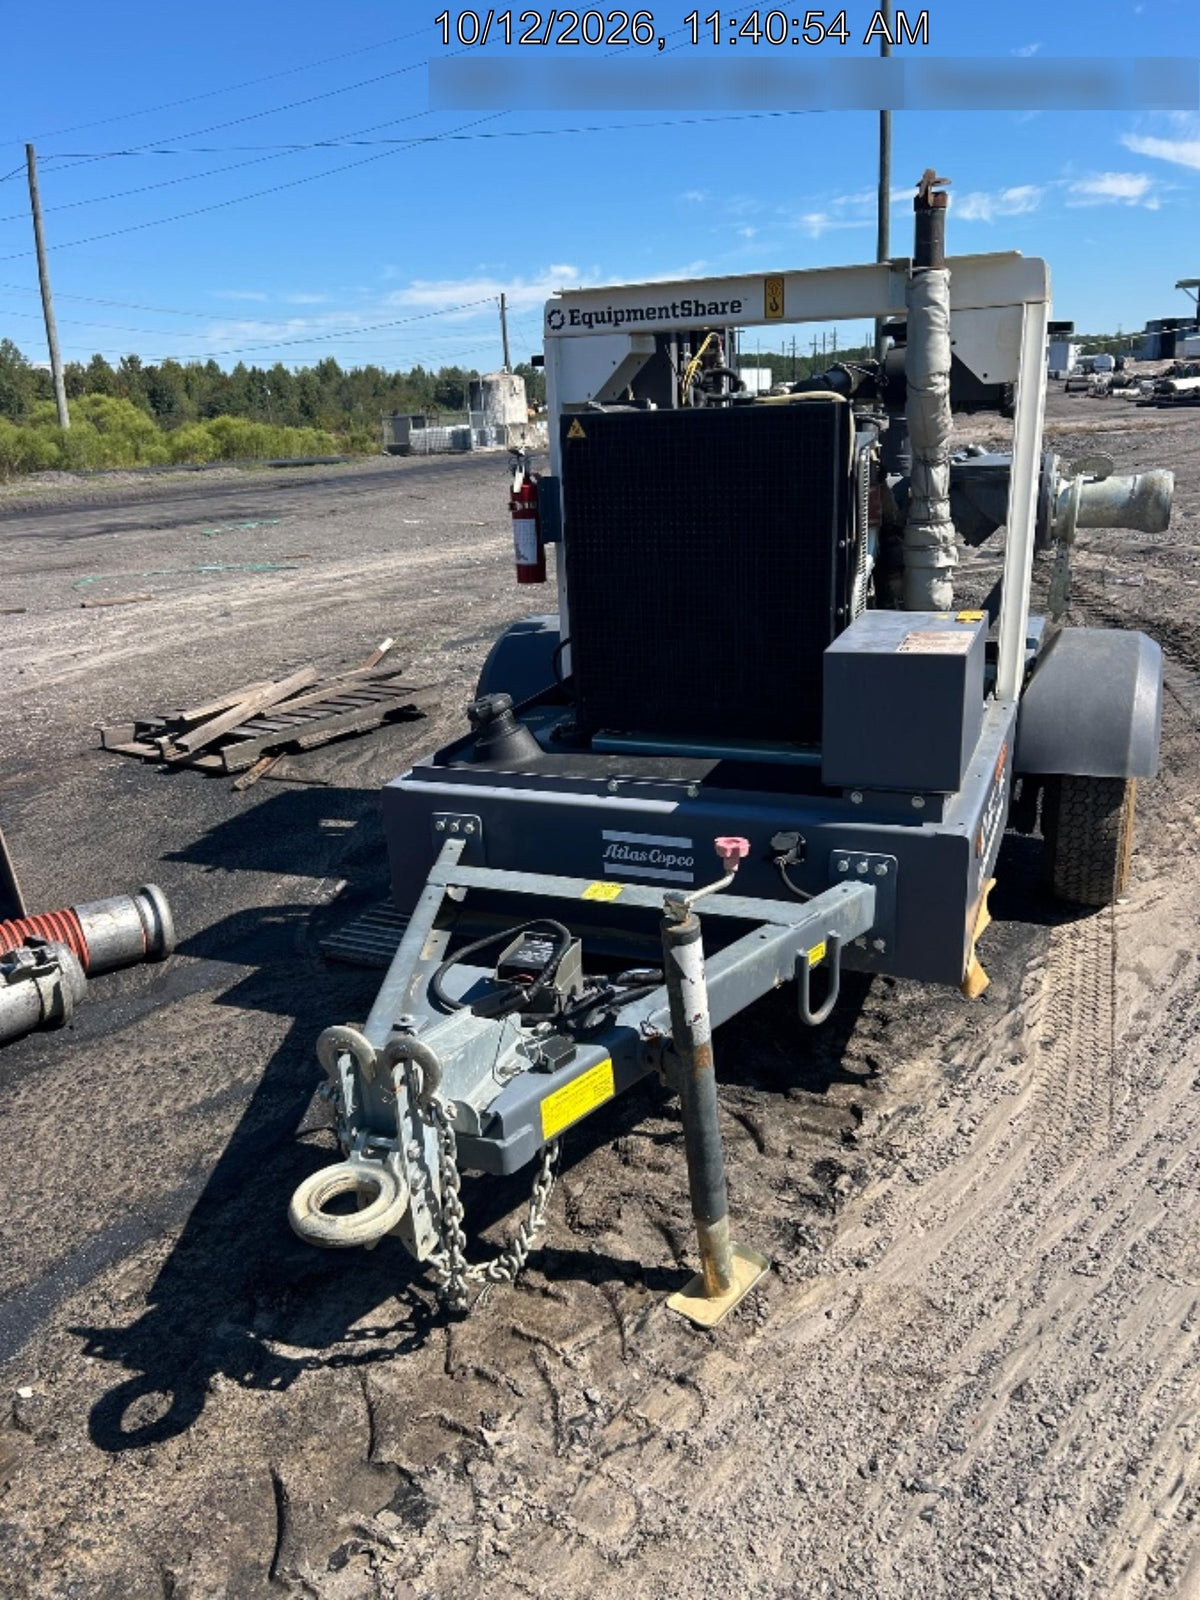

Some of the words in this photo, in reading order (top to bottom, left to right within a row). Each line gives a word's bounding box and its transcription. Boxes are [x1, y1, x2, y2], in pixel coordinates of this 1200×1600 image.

[569, 299, 742, 328] EquipmentShare
[602, 844, 648, 861] Atlas
[648, 849, 694, 867] Copco
